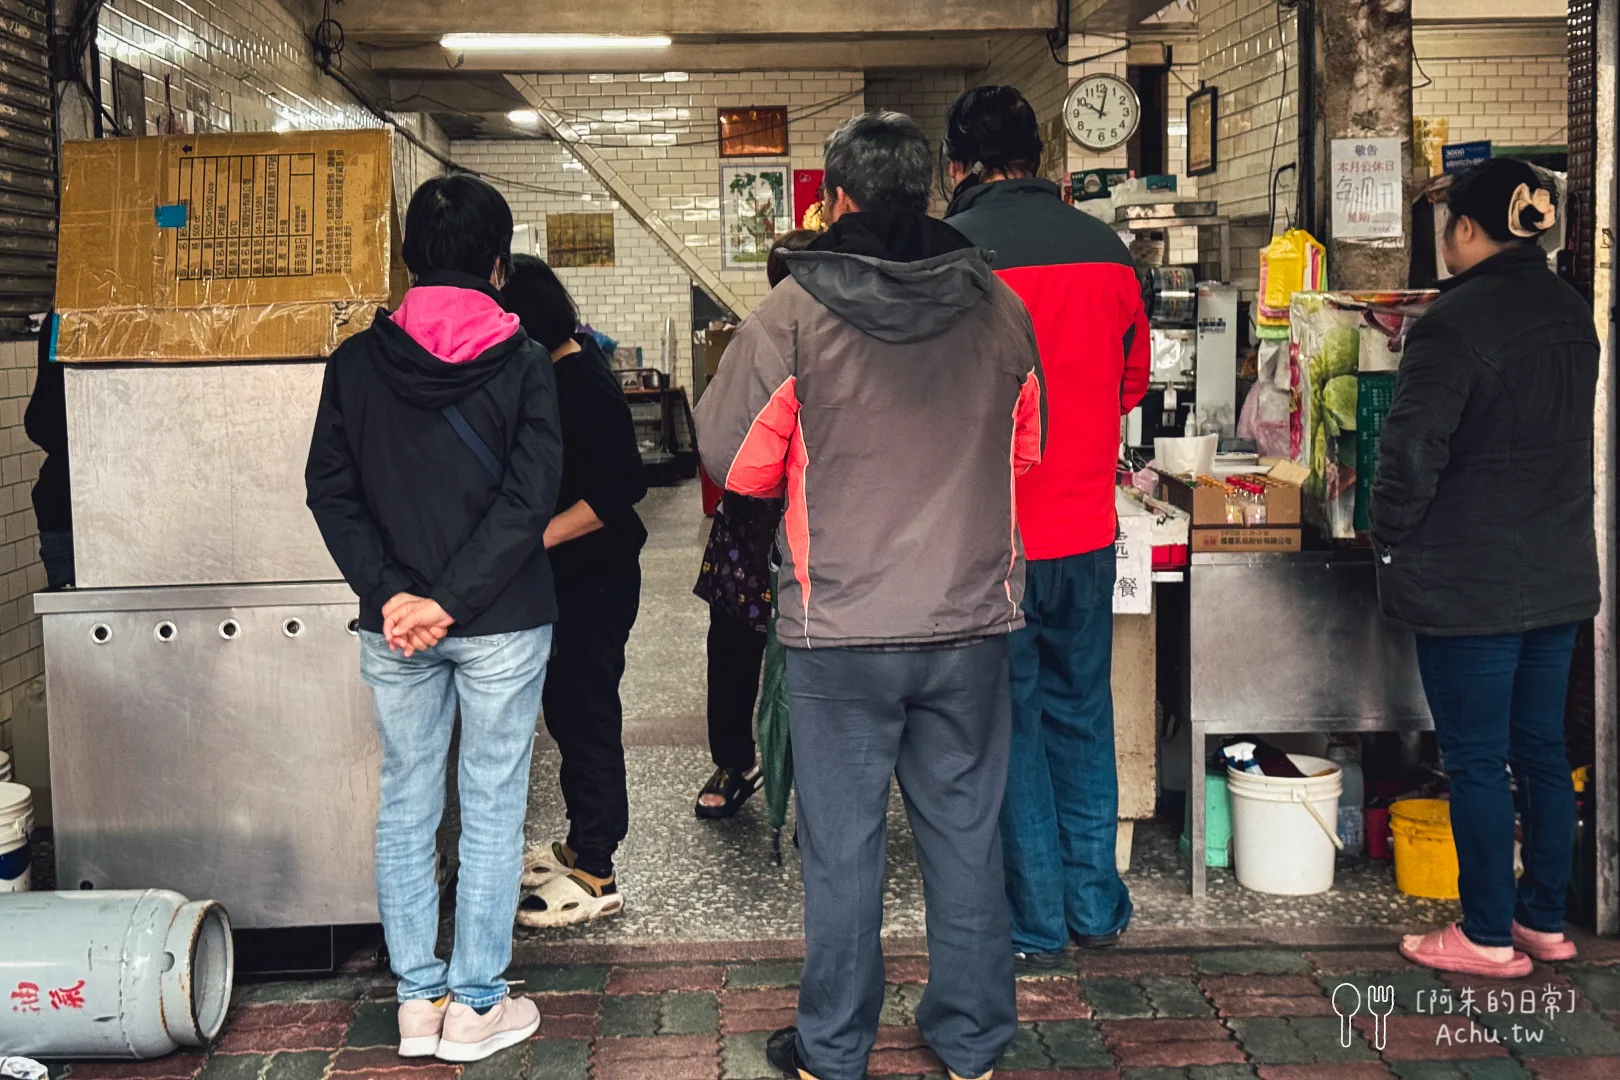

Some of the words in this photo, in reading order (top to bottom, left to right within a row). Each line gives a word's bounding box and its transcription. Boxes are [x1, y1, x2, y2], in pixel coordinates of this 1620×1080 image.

[1085, 88, 1094, 97] 11
[1096, 83, 1107, 93] 12
[1112, 87, 1116, 96] 1
[1077, 97, 1087, 107] 10
[1119, 96, 1126, 105] 2
[1073, 109, 1080, 118] 9
[1122, 108, 1129, 117] 3
[1077, 121, 1084, 130] 8
[1119, 120, 1125, 129] 4
[1086, 129, 1092, 138] 7
[1098, 132, 1105, 141] 6
[1110, 128, 1117, 137] 5
[1355, 144, 1378, 156] 敬告
[1337, 160, 1394, 172] 本月公休日
[315, 240, 324, 274] 注意事項
[1117, 576, 1138, 598] 餐
